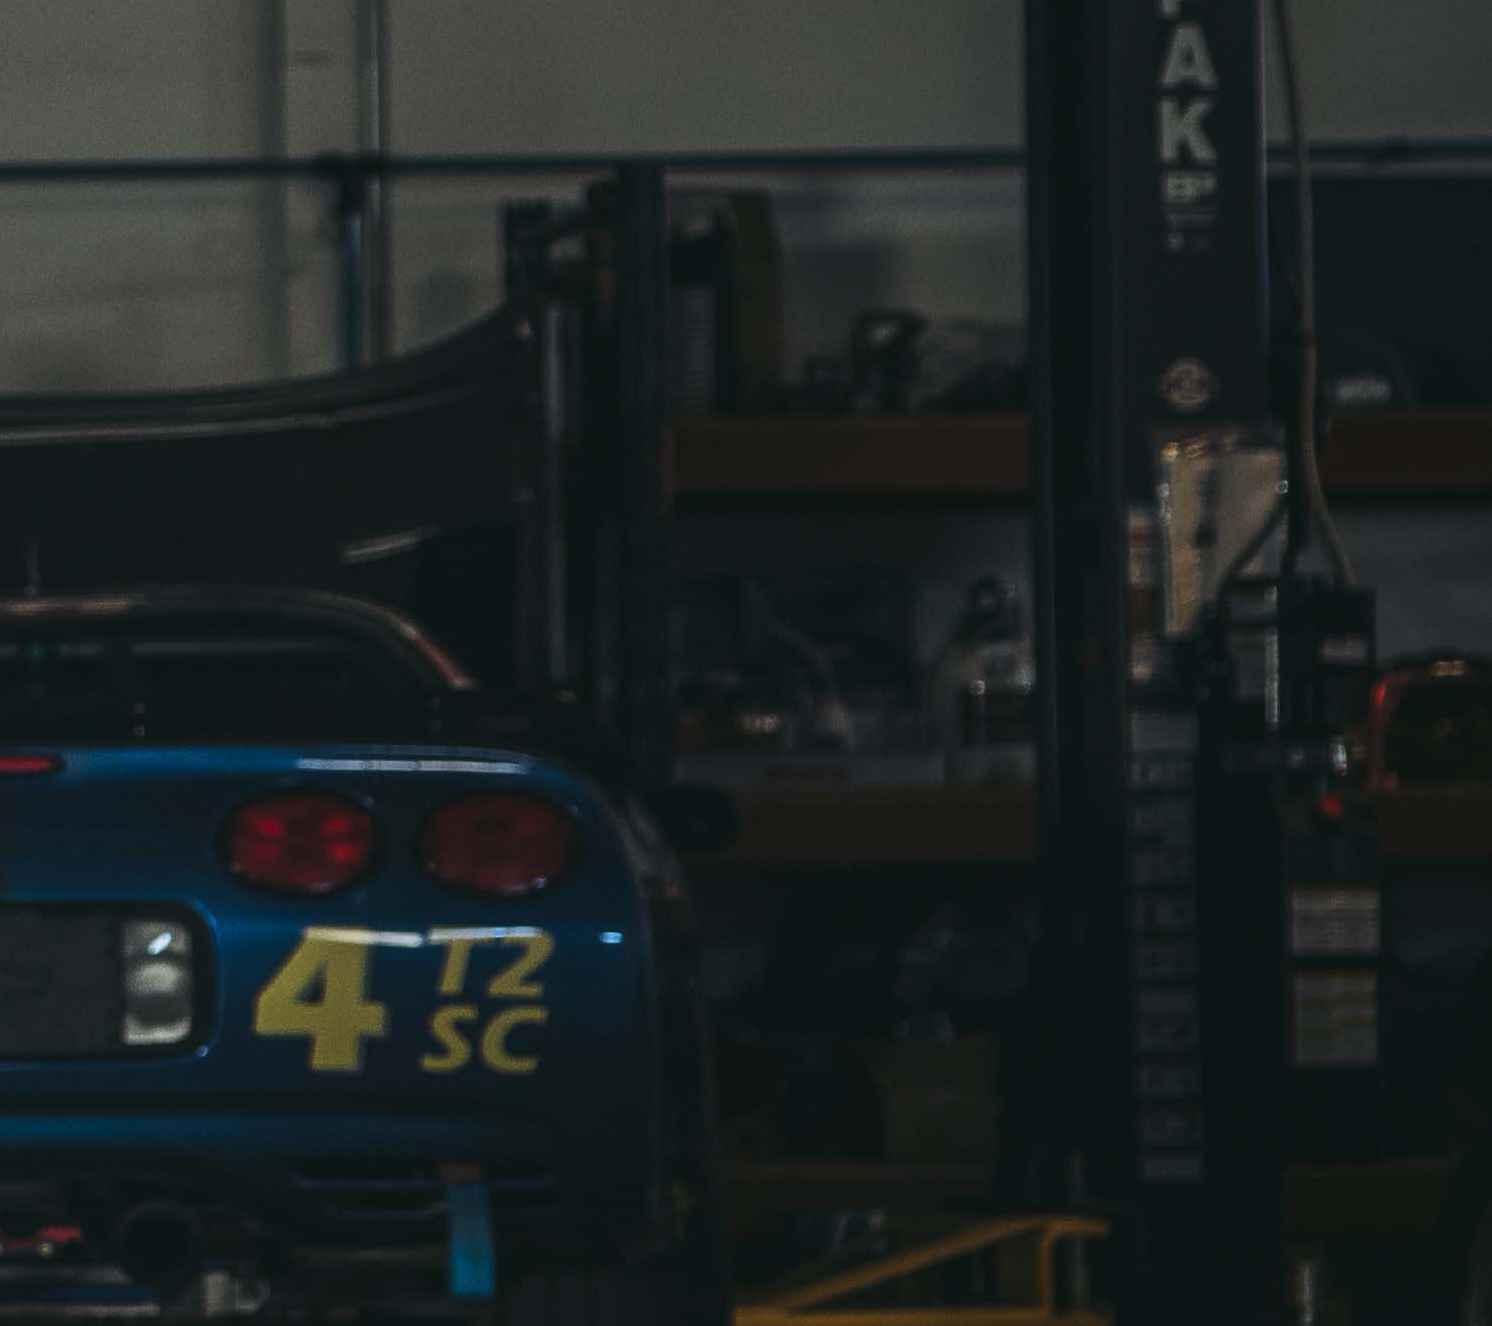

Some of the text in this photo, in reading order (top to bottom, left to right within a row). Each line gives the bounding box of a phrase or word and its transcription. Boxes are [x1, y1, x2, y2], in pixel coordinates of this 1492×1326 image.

[252, 926, 390, 1072] 4
[430, 927, 555, 999] T2
[419, 1003, 548, 1073] SC
